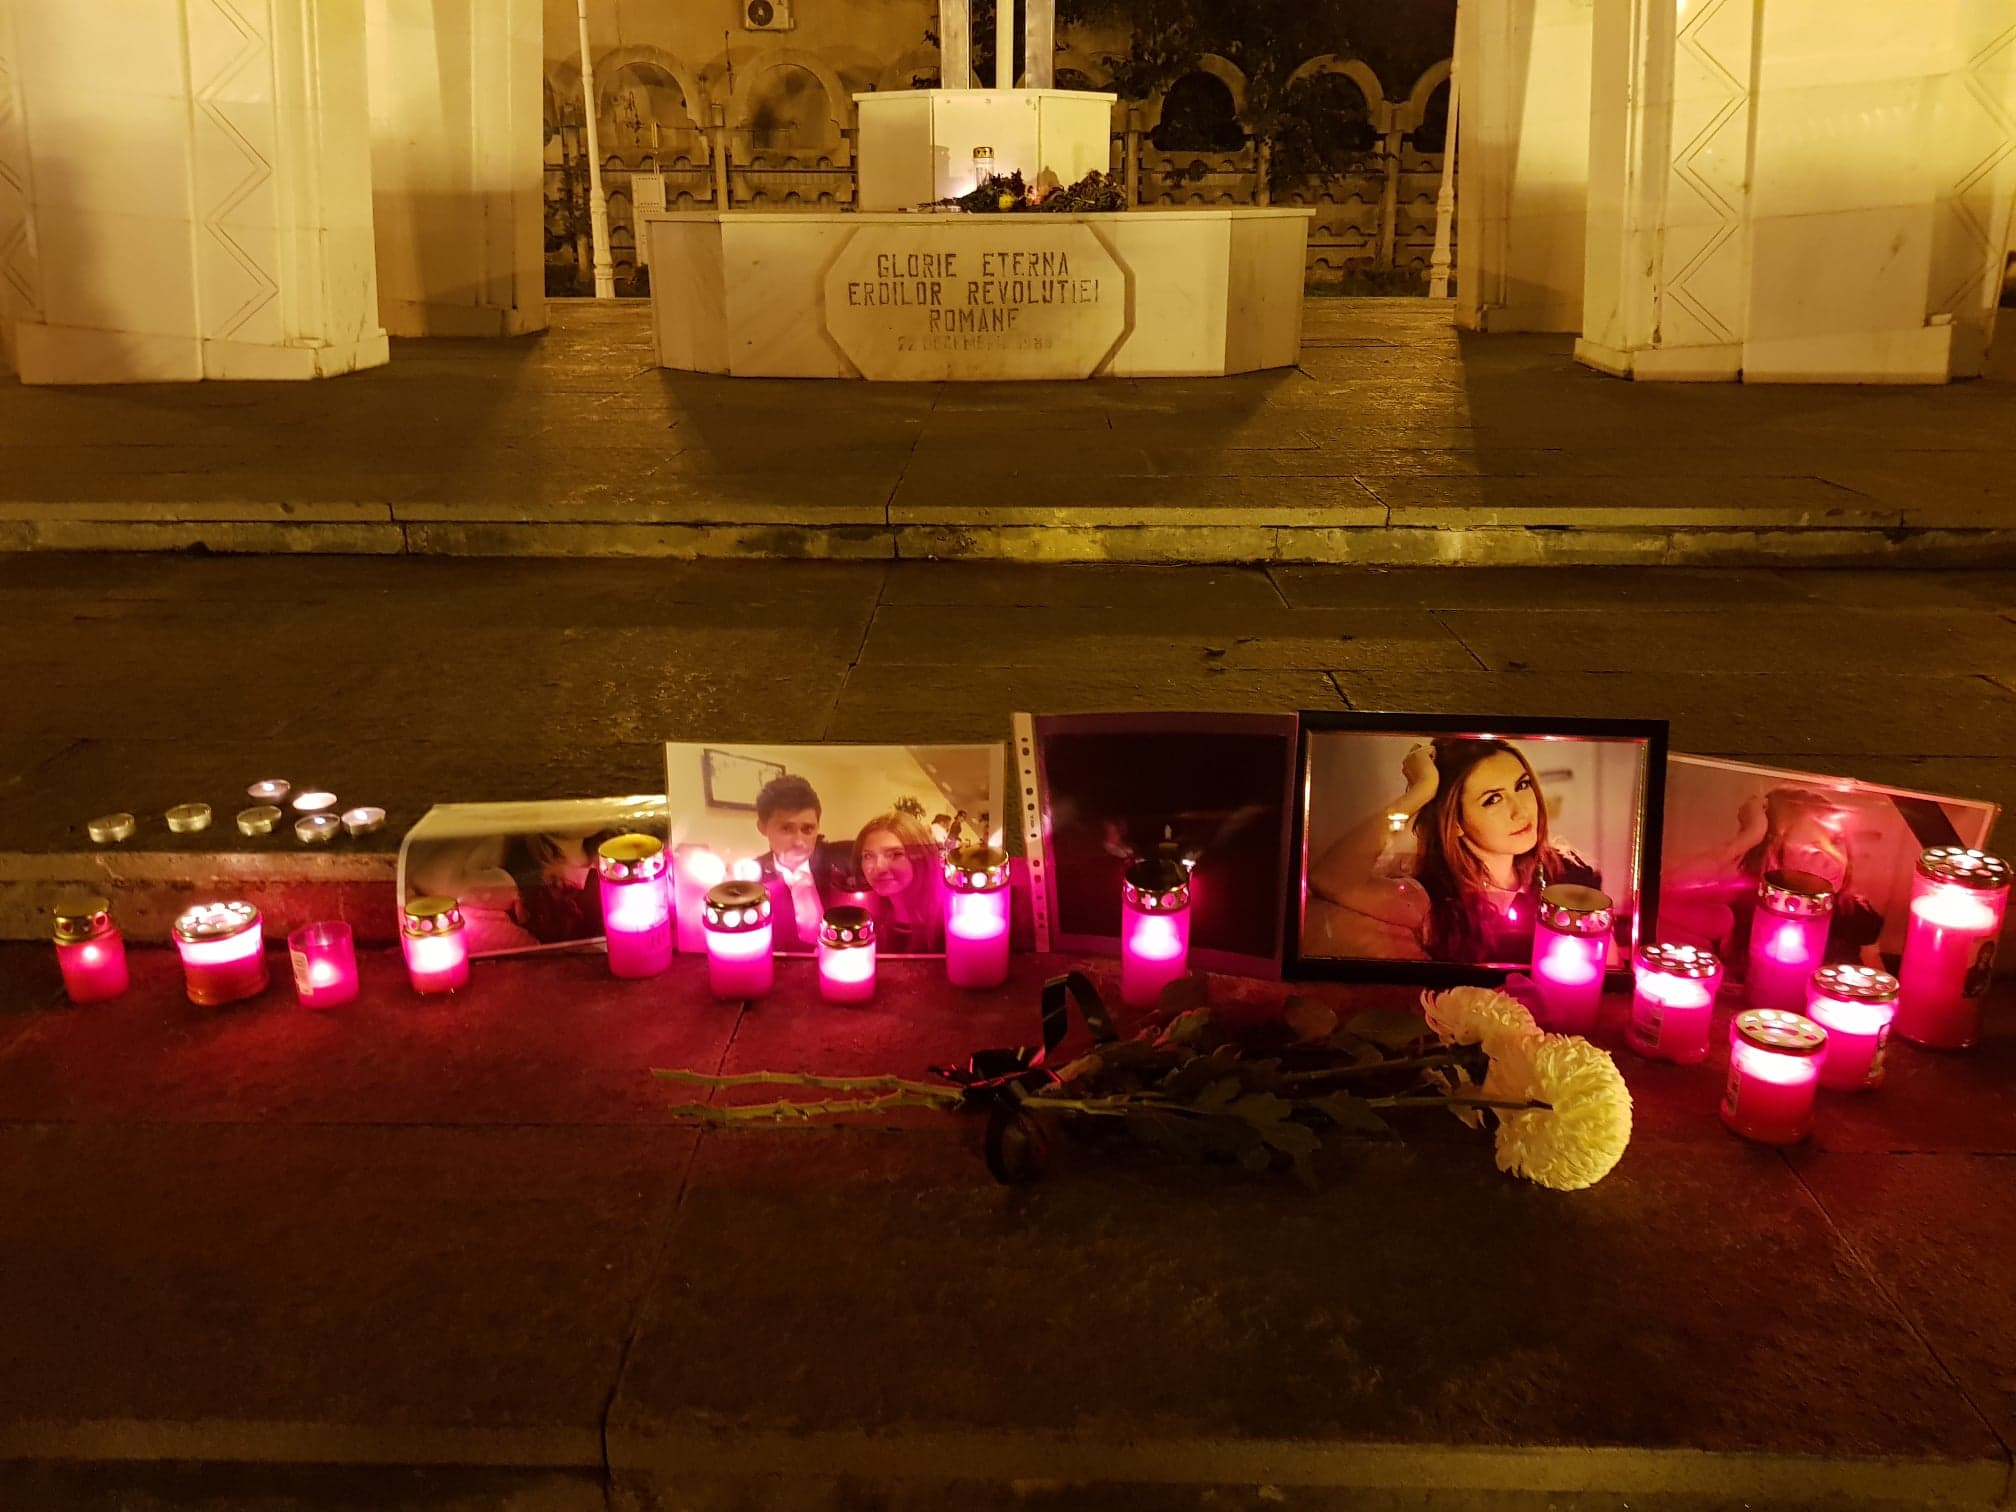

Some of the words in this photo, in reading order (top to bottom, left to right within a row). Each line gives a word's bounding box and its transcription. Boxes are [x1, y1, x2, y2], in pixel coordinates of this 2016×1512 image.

[876, 253, 958, 278] GLORIE
[981, 251, 1069, 277] ETERNA
[847, 281, 943, 306] EROILOR
[967, 279, 1100, 306] REVOLUTIEI
